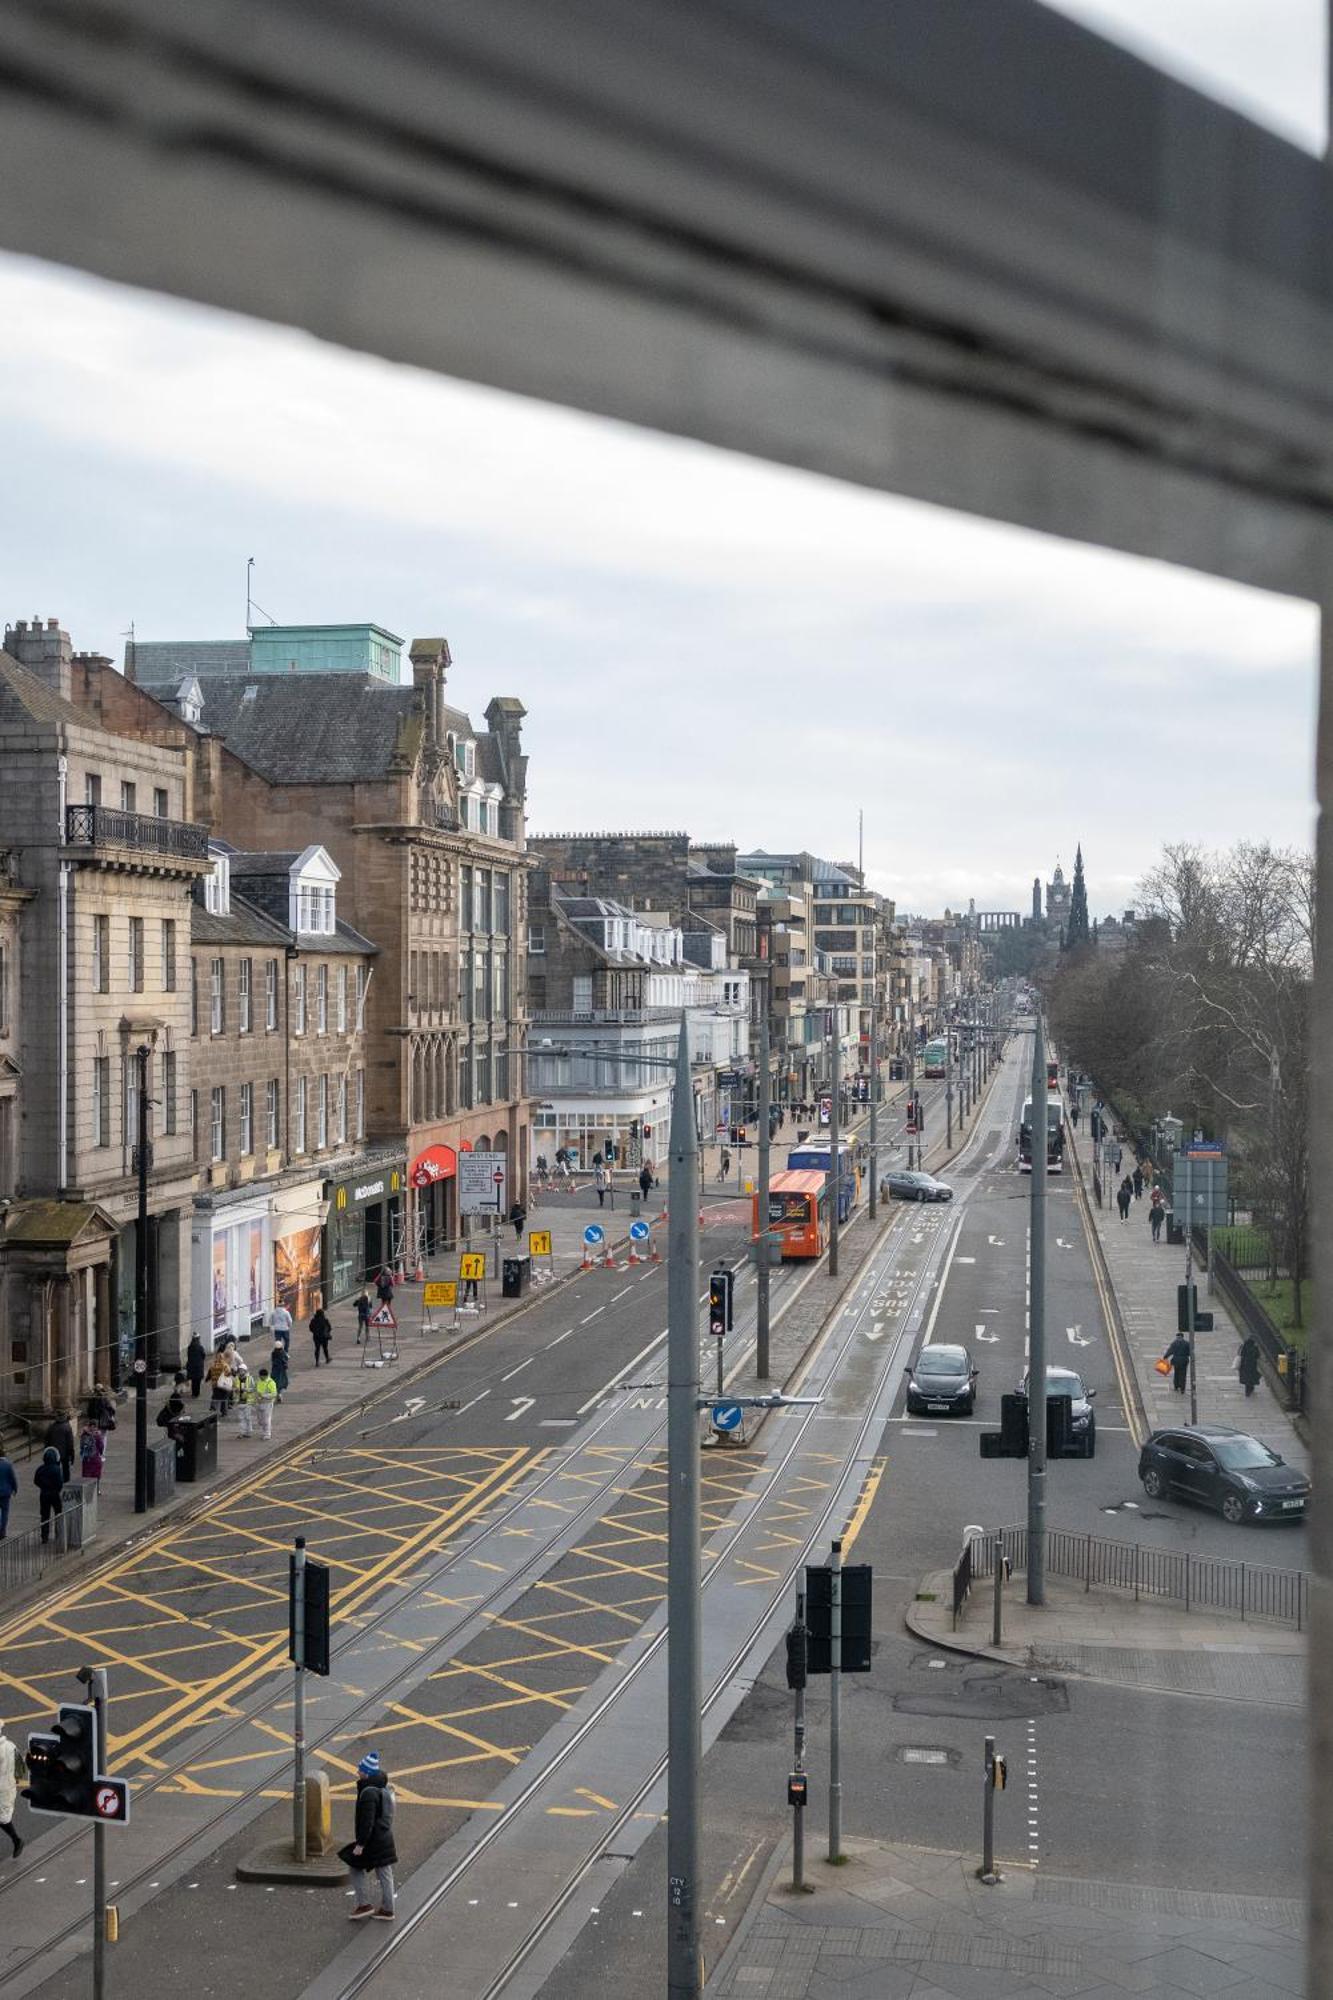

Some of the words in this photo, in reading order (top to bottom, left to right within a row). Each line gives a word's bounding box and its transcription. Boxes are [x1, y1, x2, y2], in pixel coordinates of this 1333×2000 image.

[354, 1180, 384, 1201] McDonald's
[862, 1290, 926, 1298] TAXI
[872, 1300, 909, 1308] BUS
[844, 1308, 920, 1318] TRAM
